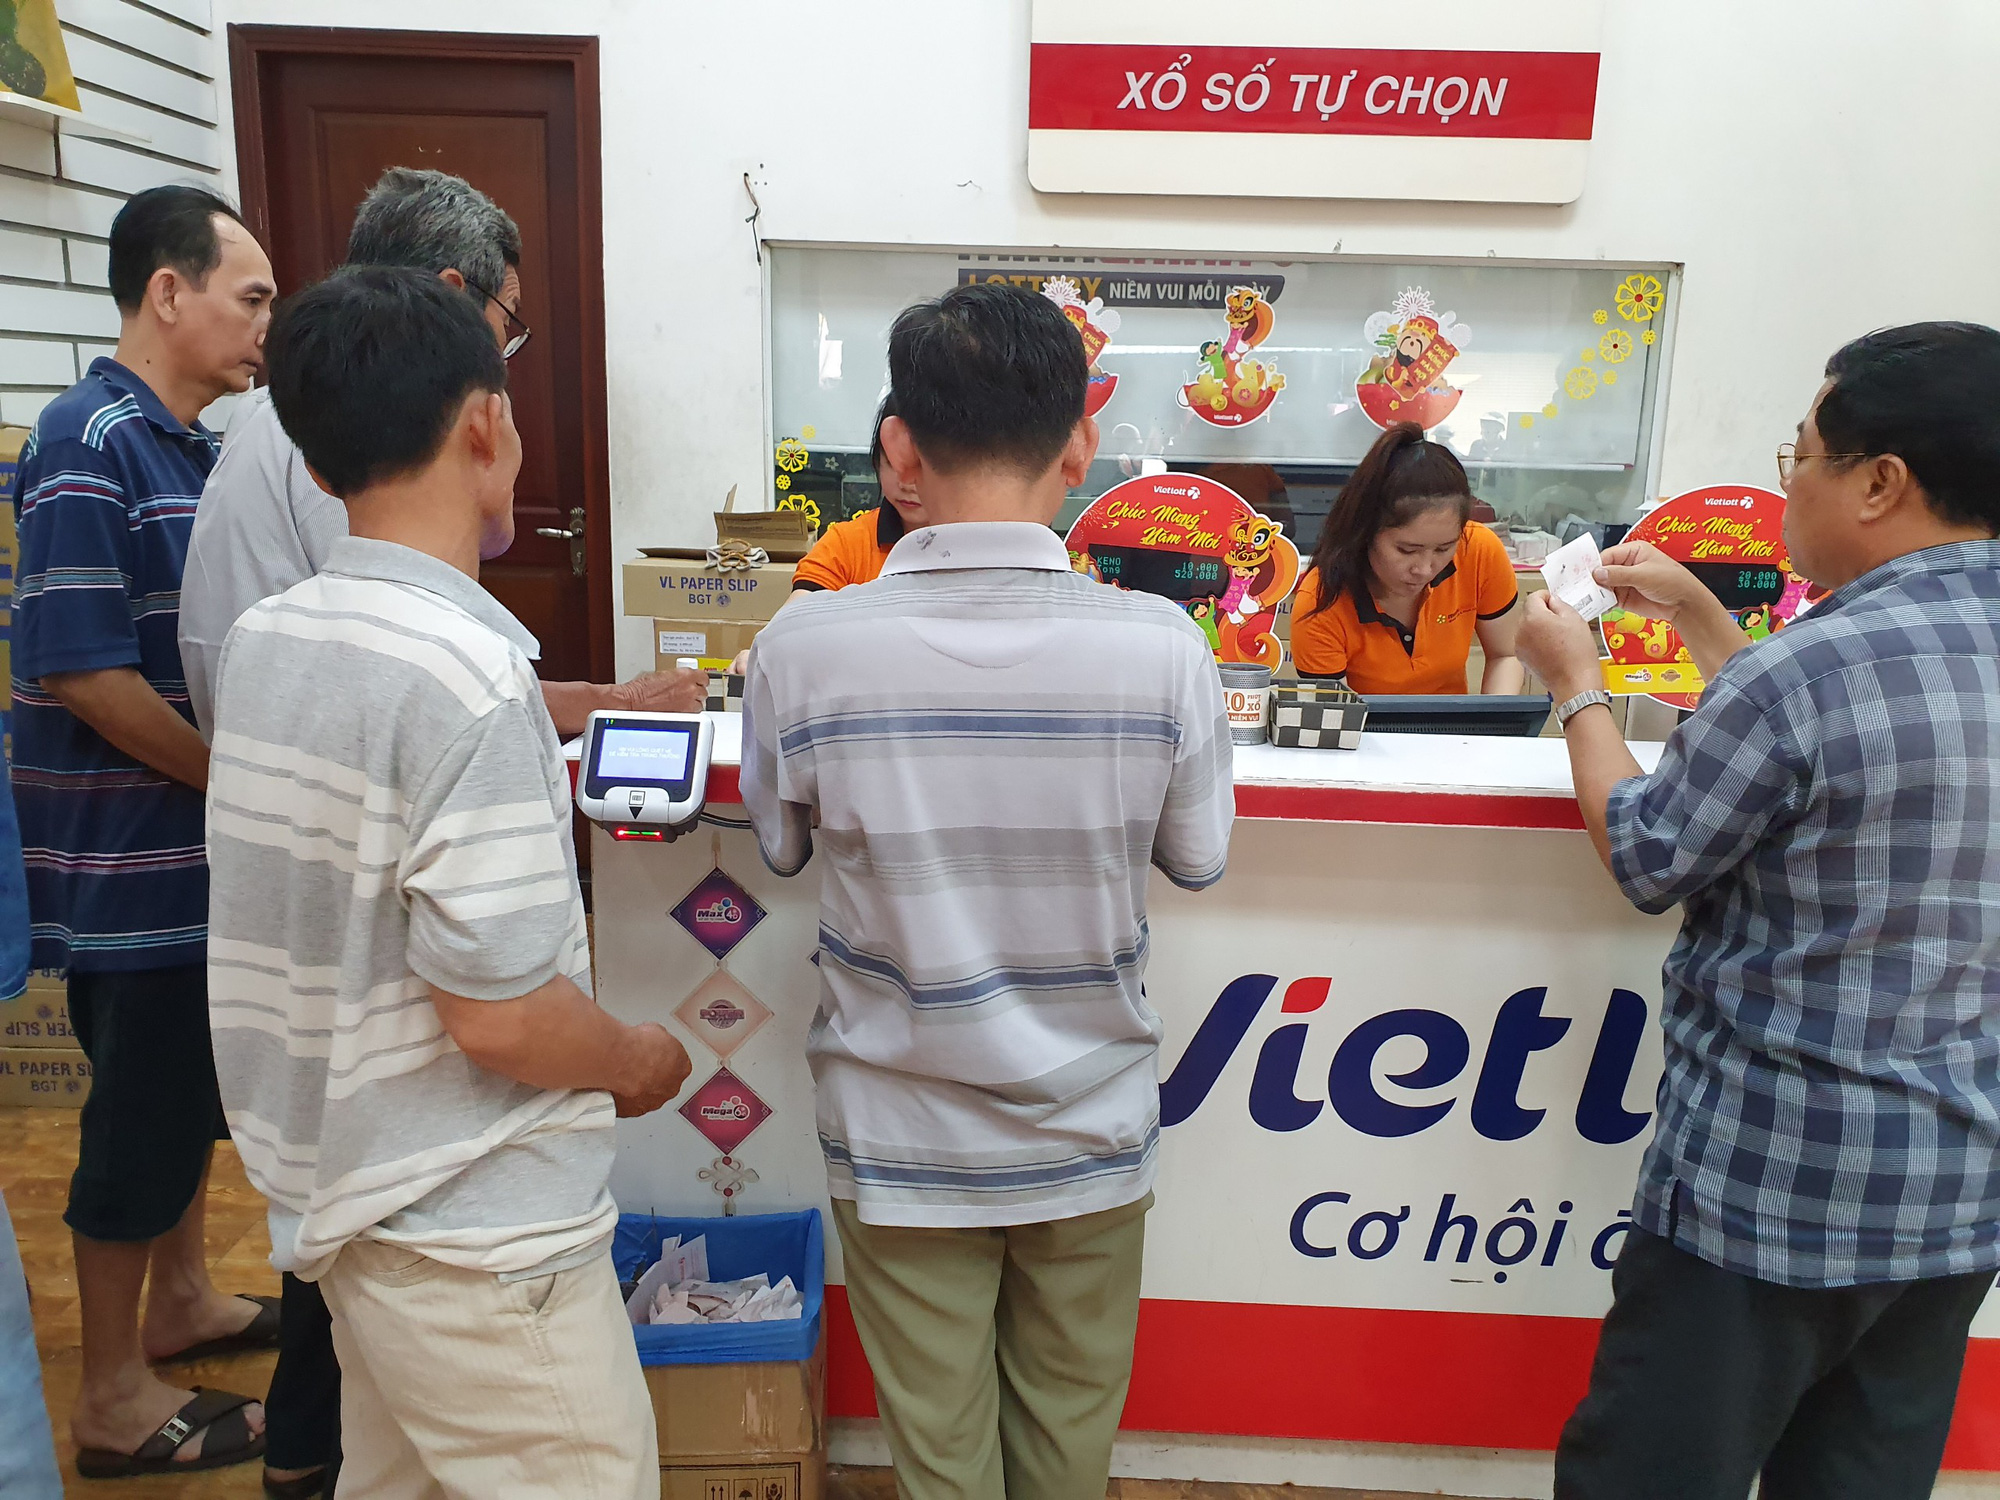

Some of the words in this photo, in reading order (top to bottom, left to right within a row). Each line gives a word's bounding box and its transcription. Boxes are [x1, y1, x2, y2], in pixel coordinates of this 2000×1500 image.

[1117, 53, 1192, 110] XỔ
[1201, 57, 1276, 113] SỐ
[1289, 70, 1357, 121] TỰ
[1364, 75, 1508, 124] CHỌN
[1109, 278, 1151, 300] NIỀM
[1156, 283, 1184, 300] VUI
[1188, 279, 1220, 302] MỖI
[1153, 486, 1186, 496] Vietlott
[1704, 497, 1739, 506] Vietlott
[1106, 501, 1147, 520] Chúc
[1655, 515, 1697, 534] Chúc
[1097, 556, 1122, 567] KENO
[1182, 562, 1219, 572] 10.000
[1174, 569, 1218, 580] 520.000
[1738, 571, 1777, 581] 20.000
[660, 576, 676, 588] VL
[680, 577, 723, 590] PAPER
[728, 579, 758, 592] SLIP
[1737, 579, 1776, 589] 30.000
[688, 594, 712, 604] BGT
[6, 1021, 40, 1036] SLIP
[1159, 973, 1653, 1145] Vietl
[20, 1062, 70, 1076] PAPER
[31, 1080, 57, 1091] BGT
[702, 1107, 733, 1115] Mega
[1289, 1191, 1410, 1260] Cơ
[1423, 1193, 1574, 1284] hội
